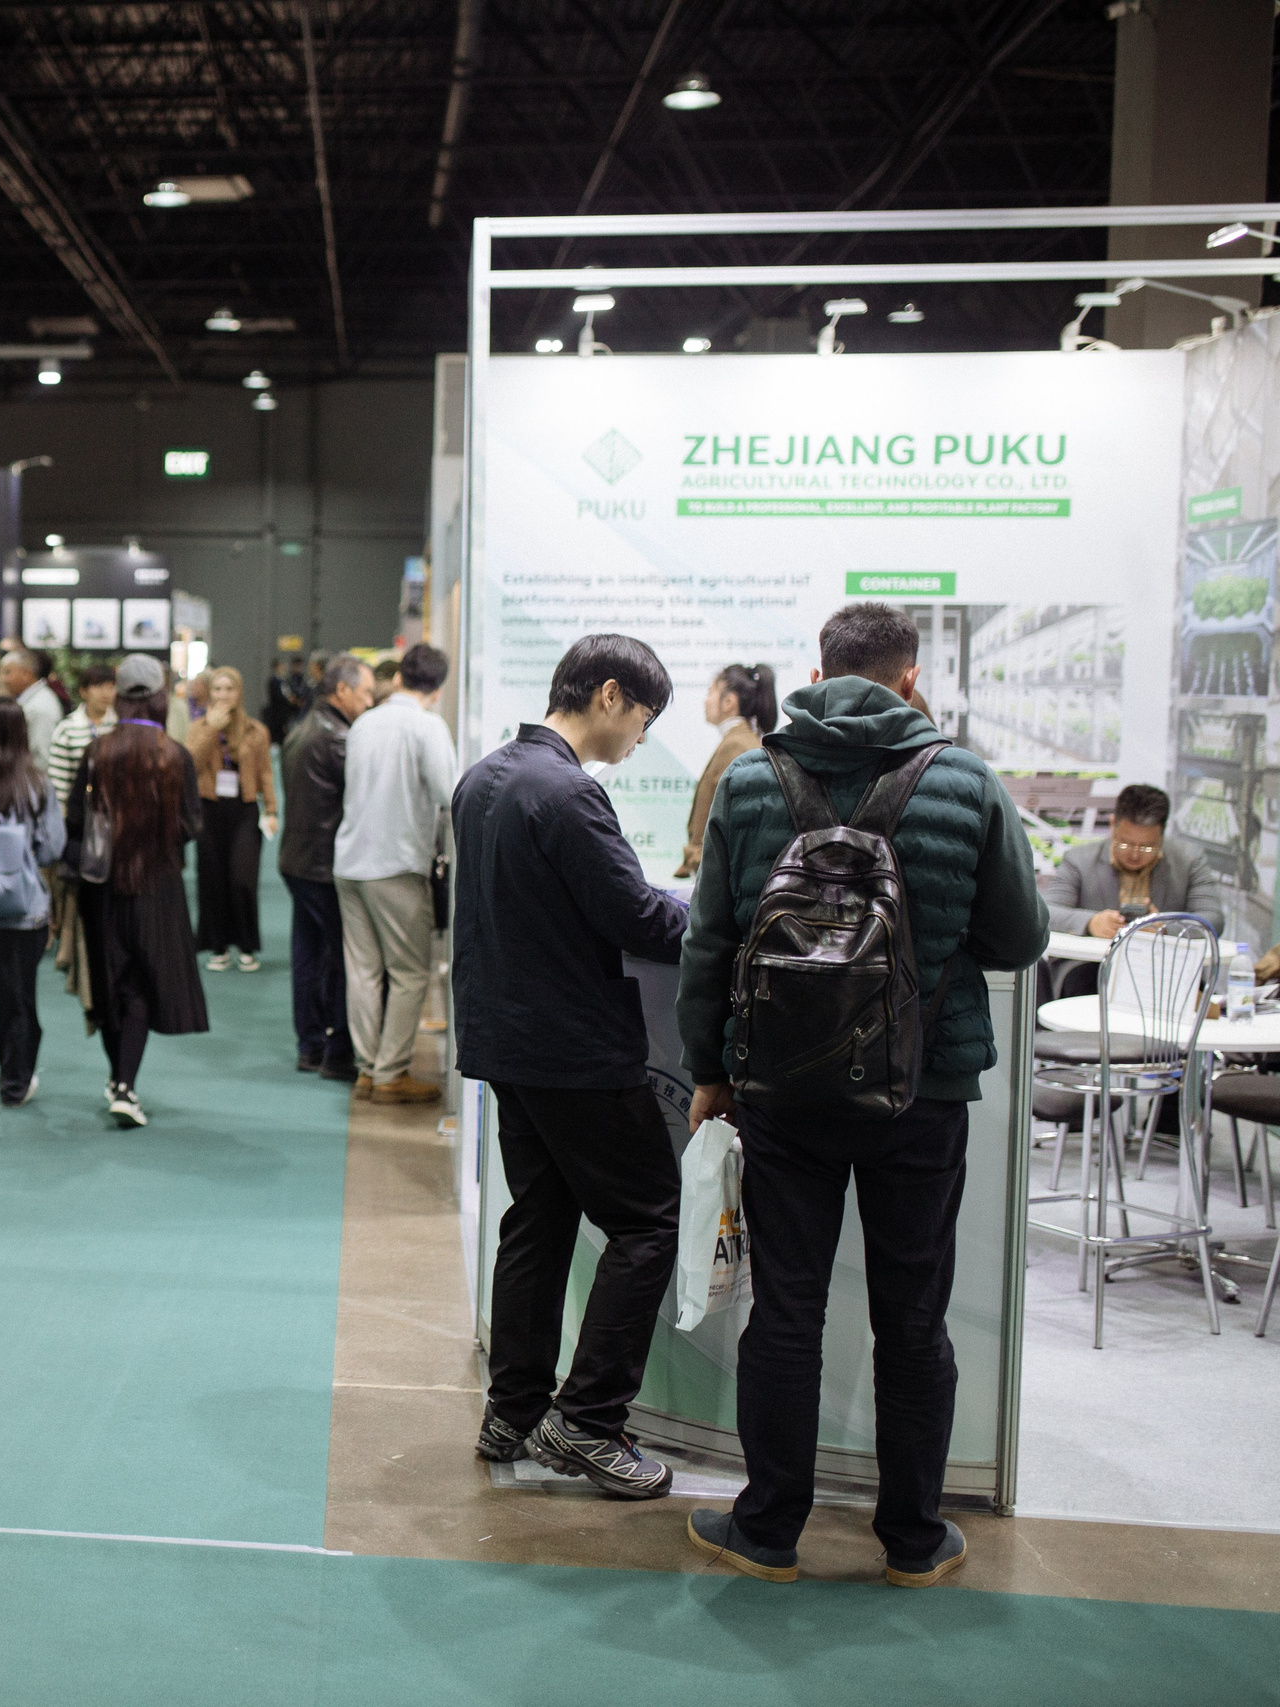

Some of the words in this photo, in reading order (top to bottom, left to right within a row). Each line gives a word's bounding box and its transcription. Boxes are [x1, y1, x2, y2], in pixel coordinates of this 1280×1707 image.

[682, 435, 916, 465] ZHEJIANG
[934, 434, 1067, 465] PUKU
[681, 473, 832, 490] AGRICULTURAL
[840, 473, 978, 490] TECHNOLOGY
[578, 499, 646, 520] PUKU
[861, 576, 941, 591] CONTAINER
